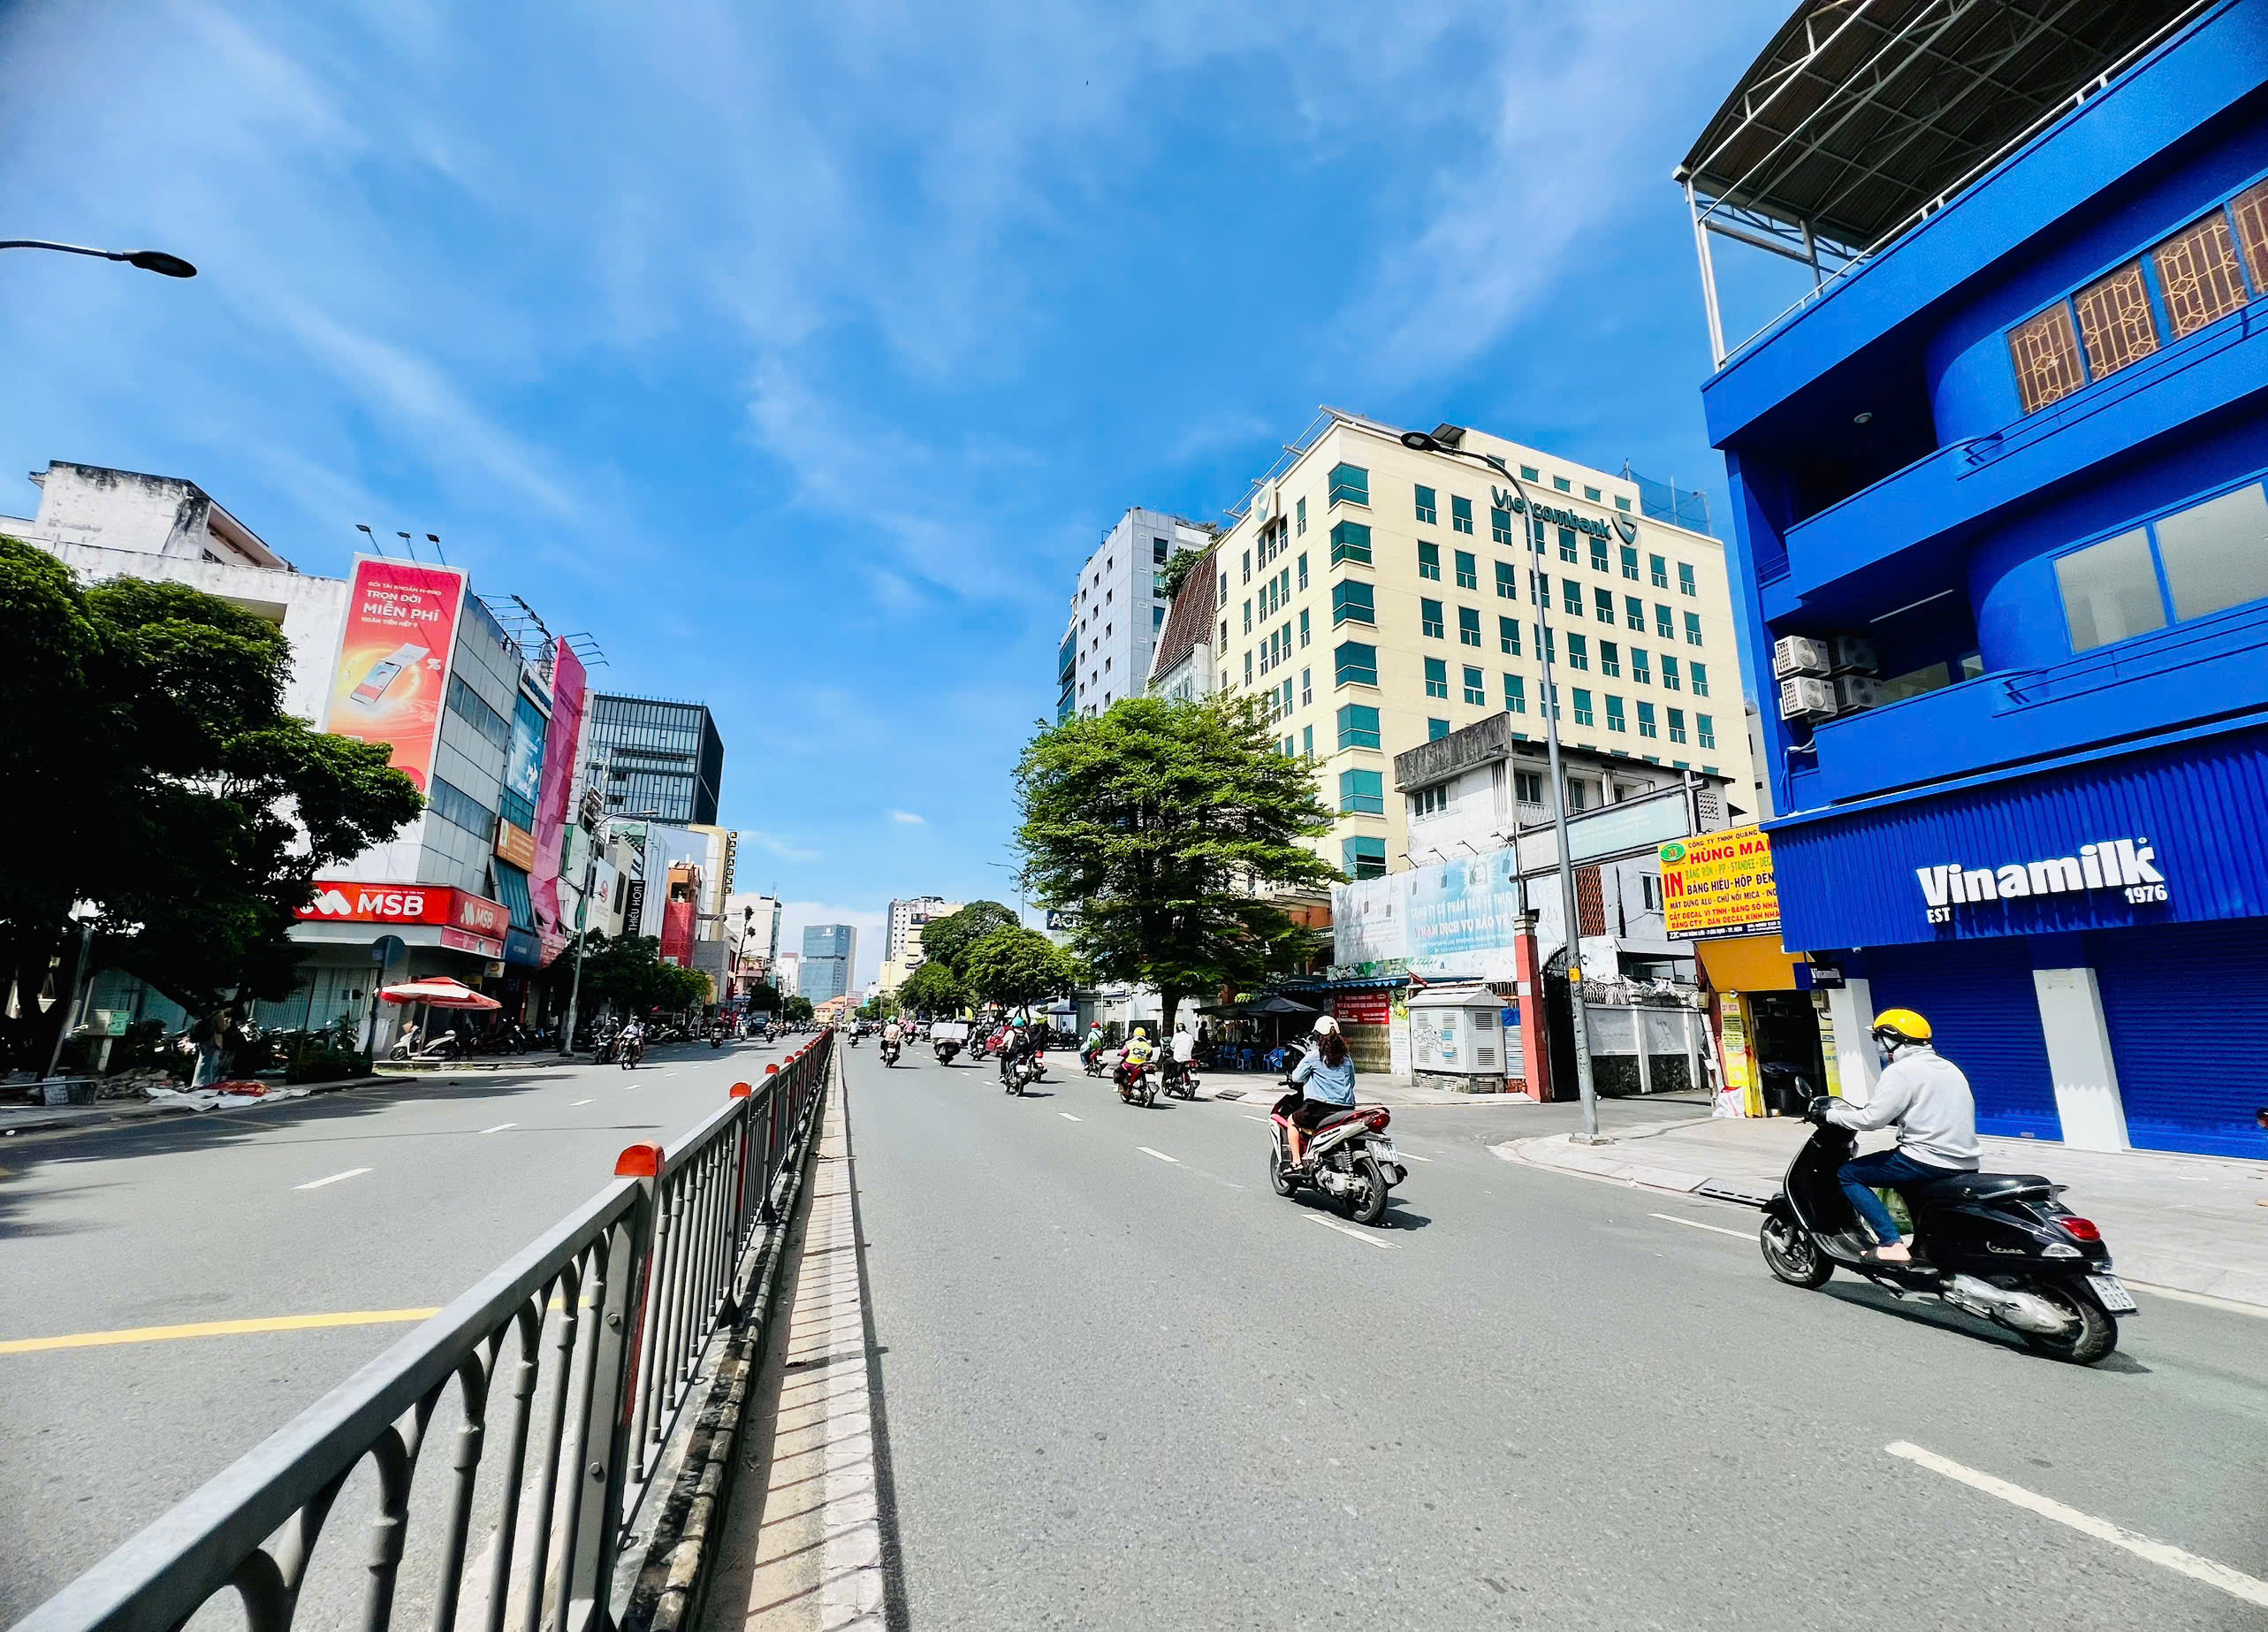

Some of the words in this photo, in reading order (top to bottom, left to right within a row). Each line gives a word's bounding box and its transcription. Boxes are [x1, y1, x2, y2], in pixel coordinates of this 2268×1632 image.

[1492, 485, 1612, 539] Viecombank
[367, 590, 398, 602] TRỌN
[400, 593, 422, 604] ĐỜI
[362, 601, 407, 618] MIỄN
[410, 608, 440, 622] PHÍ
[725, 832, 738, 894] KARAOKE
[1690, 846, 1735, 865] HÙNG
[1916, 836, 2165, 906] Vinamilk
[1663, 871, 1684, 898] IN
[1686, 881, 1709, 896] BẢNG
[1710, 877, 1730, 893] HIỆU
[1734, 873, 1753, 889] HỘP
[1755, 870, 1776, 885] ĐÈN
[357, 893, 423, 916] MSB
[631, 886, 643, 906] HOA
[1744, 889, 1760, 900] MICA
[2124, 885, 2167, 904] 1976
[476, 908, 493, 929] MSB
[1723, 914, 1744, 924] DECAL
[1927, 906, 1951, 924] EST
